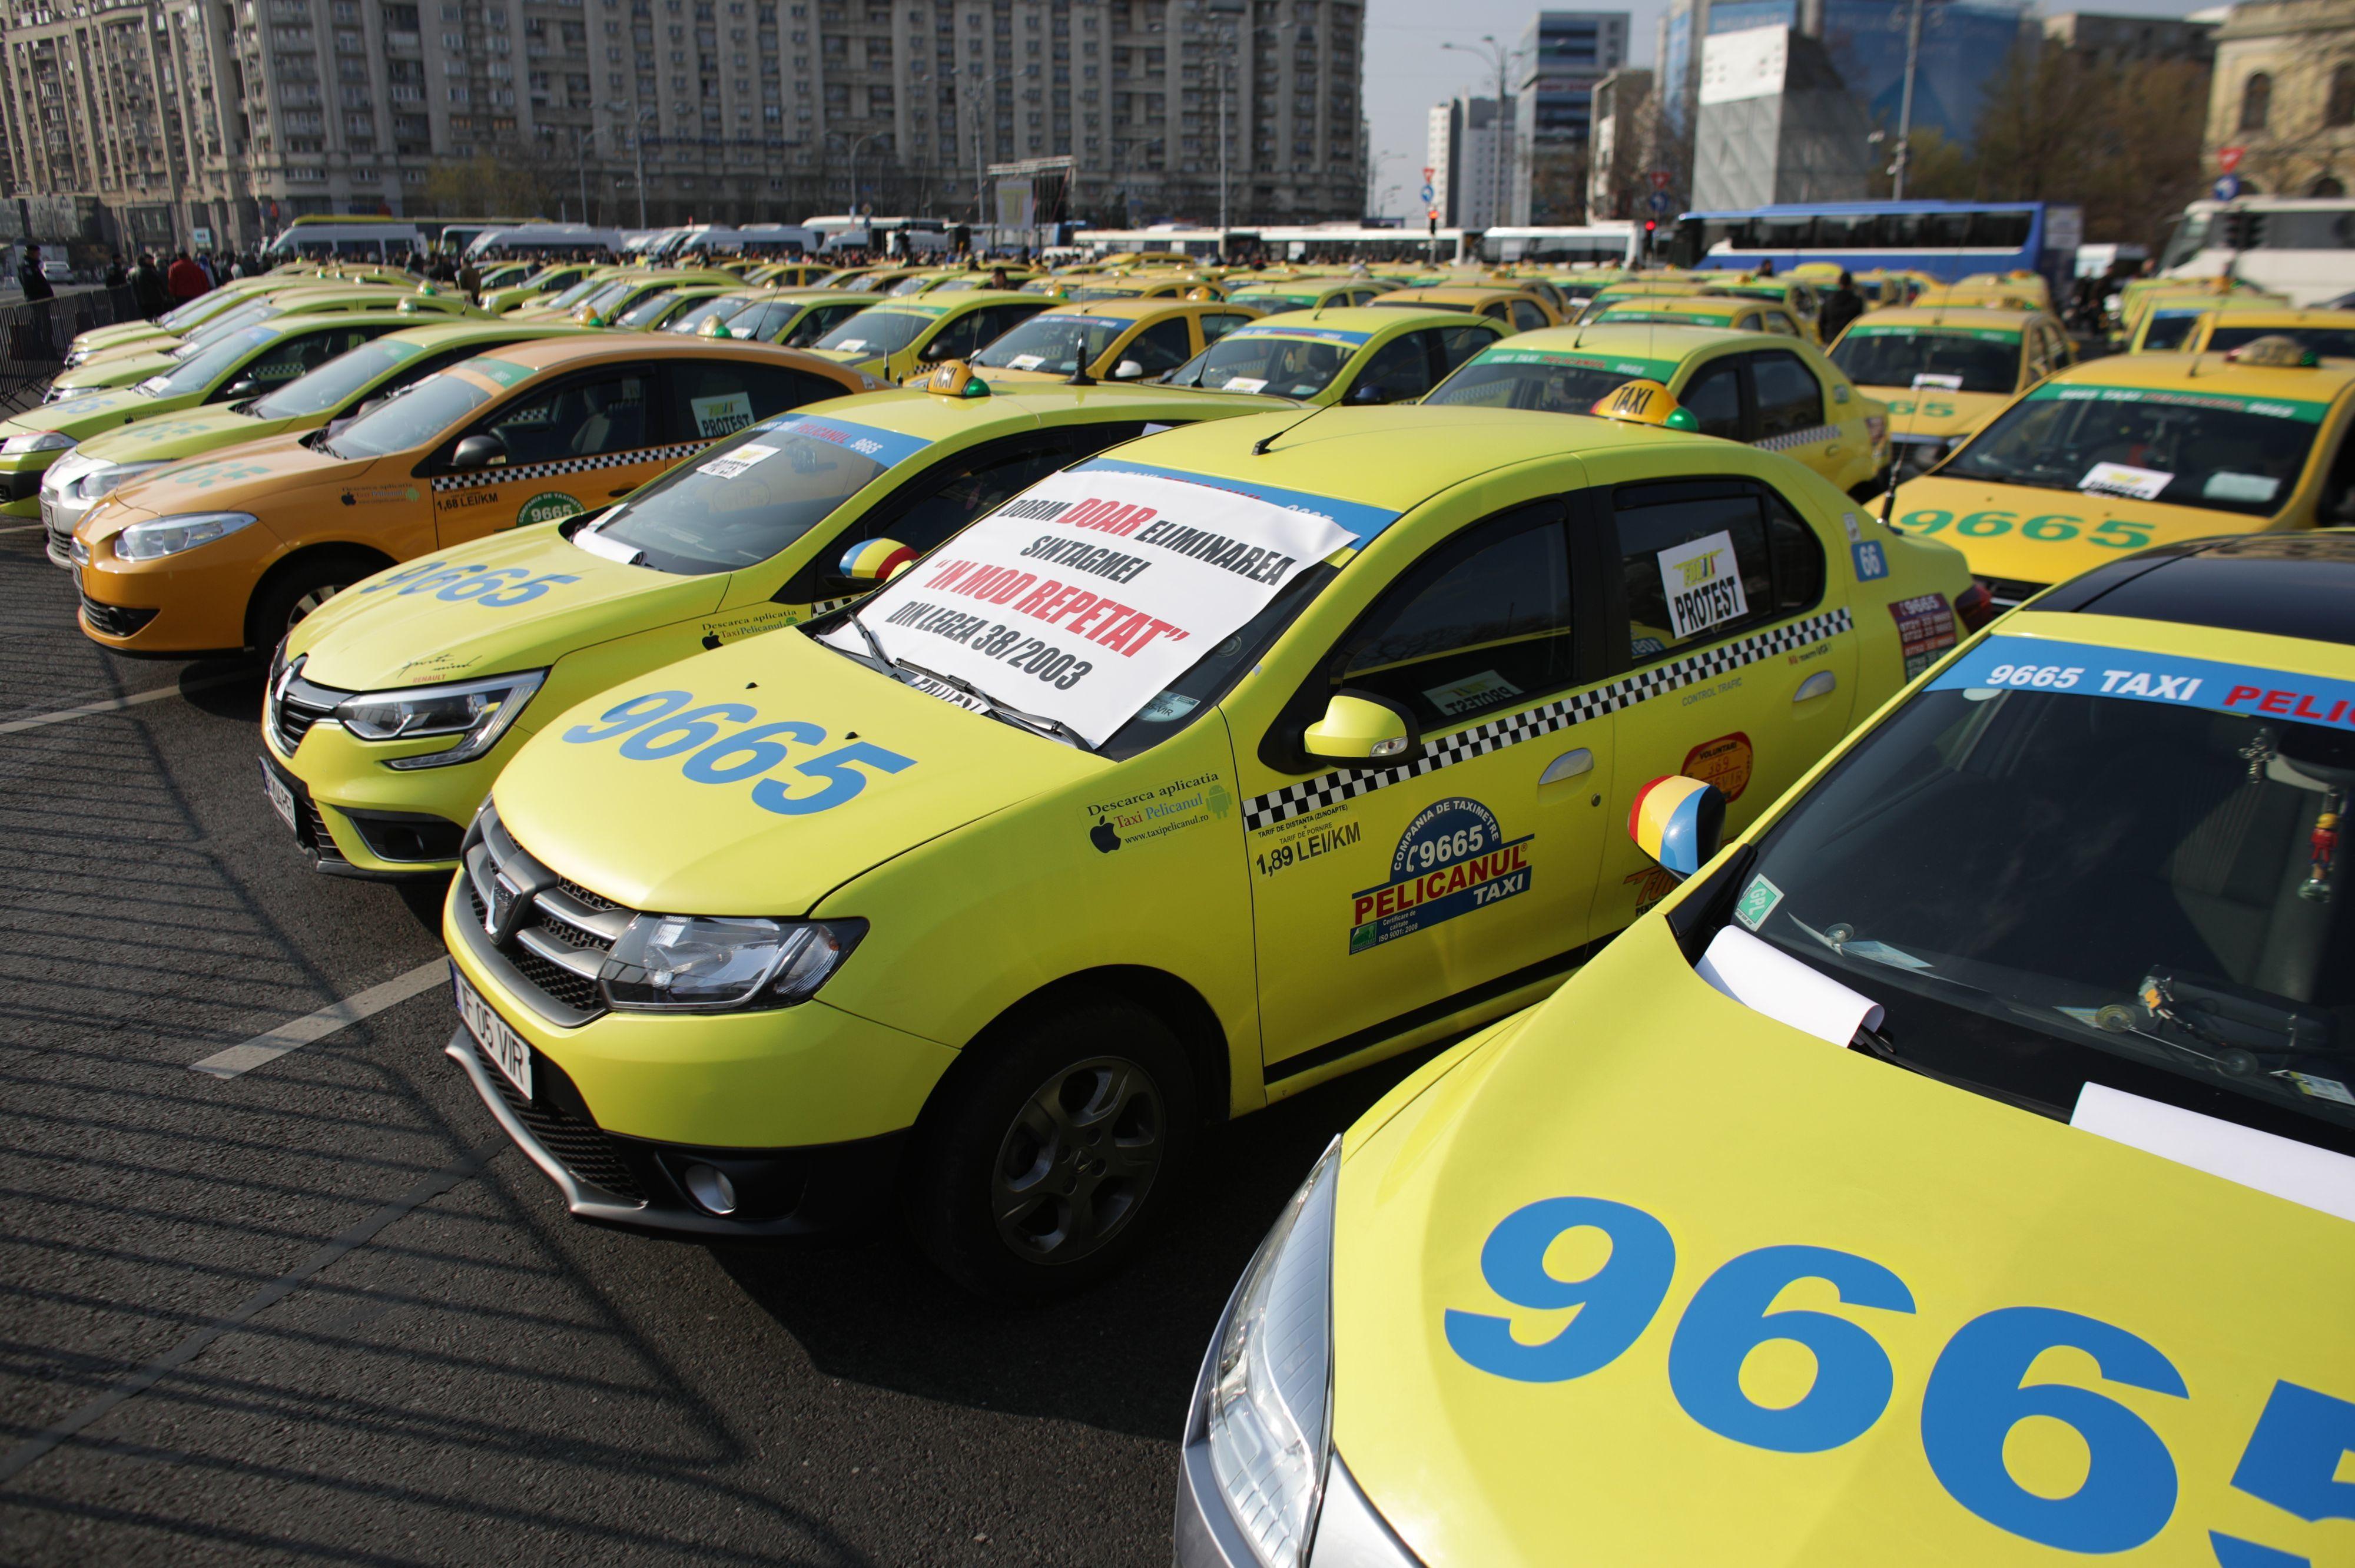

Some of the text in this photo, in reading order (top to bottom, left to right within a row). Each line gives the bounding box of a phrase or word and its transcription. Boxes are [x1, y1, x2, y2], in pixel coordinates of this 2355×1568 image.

[1612, 386, 1654, 415] TAXI
[701, 413, 751, 437] PROTEST
[850, 437, 883, 455] 9665
[436, 500, 459, 512] 1,68
[460, 492, 499, 508] LEI/KM
[530, 504, 572, 522] 9665
[997, 498, 1297, 586] DORIM DOAR ELIMINAREA
[1900, 509, 2156, 549] 9665
[1020, 535, 1153, 585] SINTAGMEI
[1859, 543, 1882, 576] 66
[359, 561, 583, 608] 9665
[950, 563, 1038, 606] MOD
[702, 609, 797, 631] Descarca aplicatia
[1674, 575, 1740, 635] PROTEST
[719, 621, 784, 639] Taxi Pelicanul
[884, 601, 1093, 691] DIN LEGEA 38/2003
[412, 673, 446, 684] RENAULT
[1681, 677, 1743, 707] CONTROL TRAFIC
[1986, 664, 2085, 688] 9665
[2099, 669, 2203, 701] TAXI
[2223, 684, 2355, 724] PELI
[562, 690, 918, 816] 9665
[1699, 741, 1737, 760] VOLUNTARI
[1087, 773, 1220, 817] Descarca aplicatia
[1113, 793, 1203, 829] Taxi Pelicanul
[1124, 814, 1209, 844] www.taxipelicanul.ro
[1258, 803, 1349, 838] TARIF DE DISTANTA (ZI/NOAPTE)
[1279, 835, 1296, 845] TARIF
[1306, 821, 1334, 836] PORNIRE
[1393, 800, 1500, 871] COMPANIA DE TAXIMETRE
[1255, 821, 1361, 878] 1,89 LEI/KM
[1419, 824, 1484, 868] 9665
[1355, 844, 1527, 926] PELICANUL
[1472, 873, 1524, 906] TAXI
[1748, 887, 1767, 916] GPL
[1378, 933, 1389, 942] ISO
[1405, 922, 1419, 934] 2008
[1382, 913, 1409, 926] Certificare
[1389, 920, 1409, 931] calitate
[476, 1001, 494, 1049] 05
[497, 1022, 524, 1086] VIR
